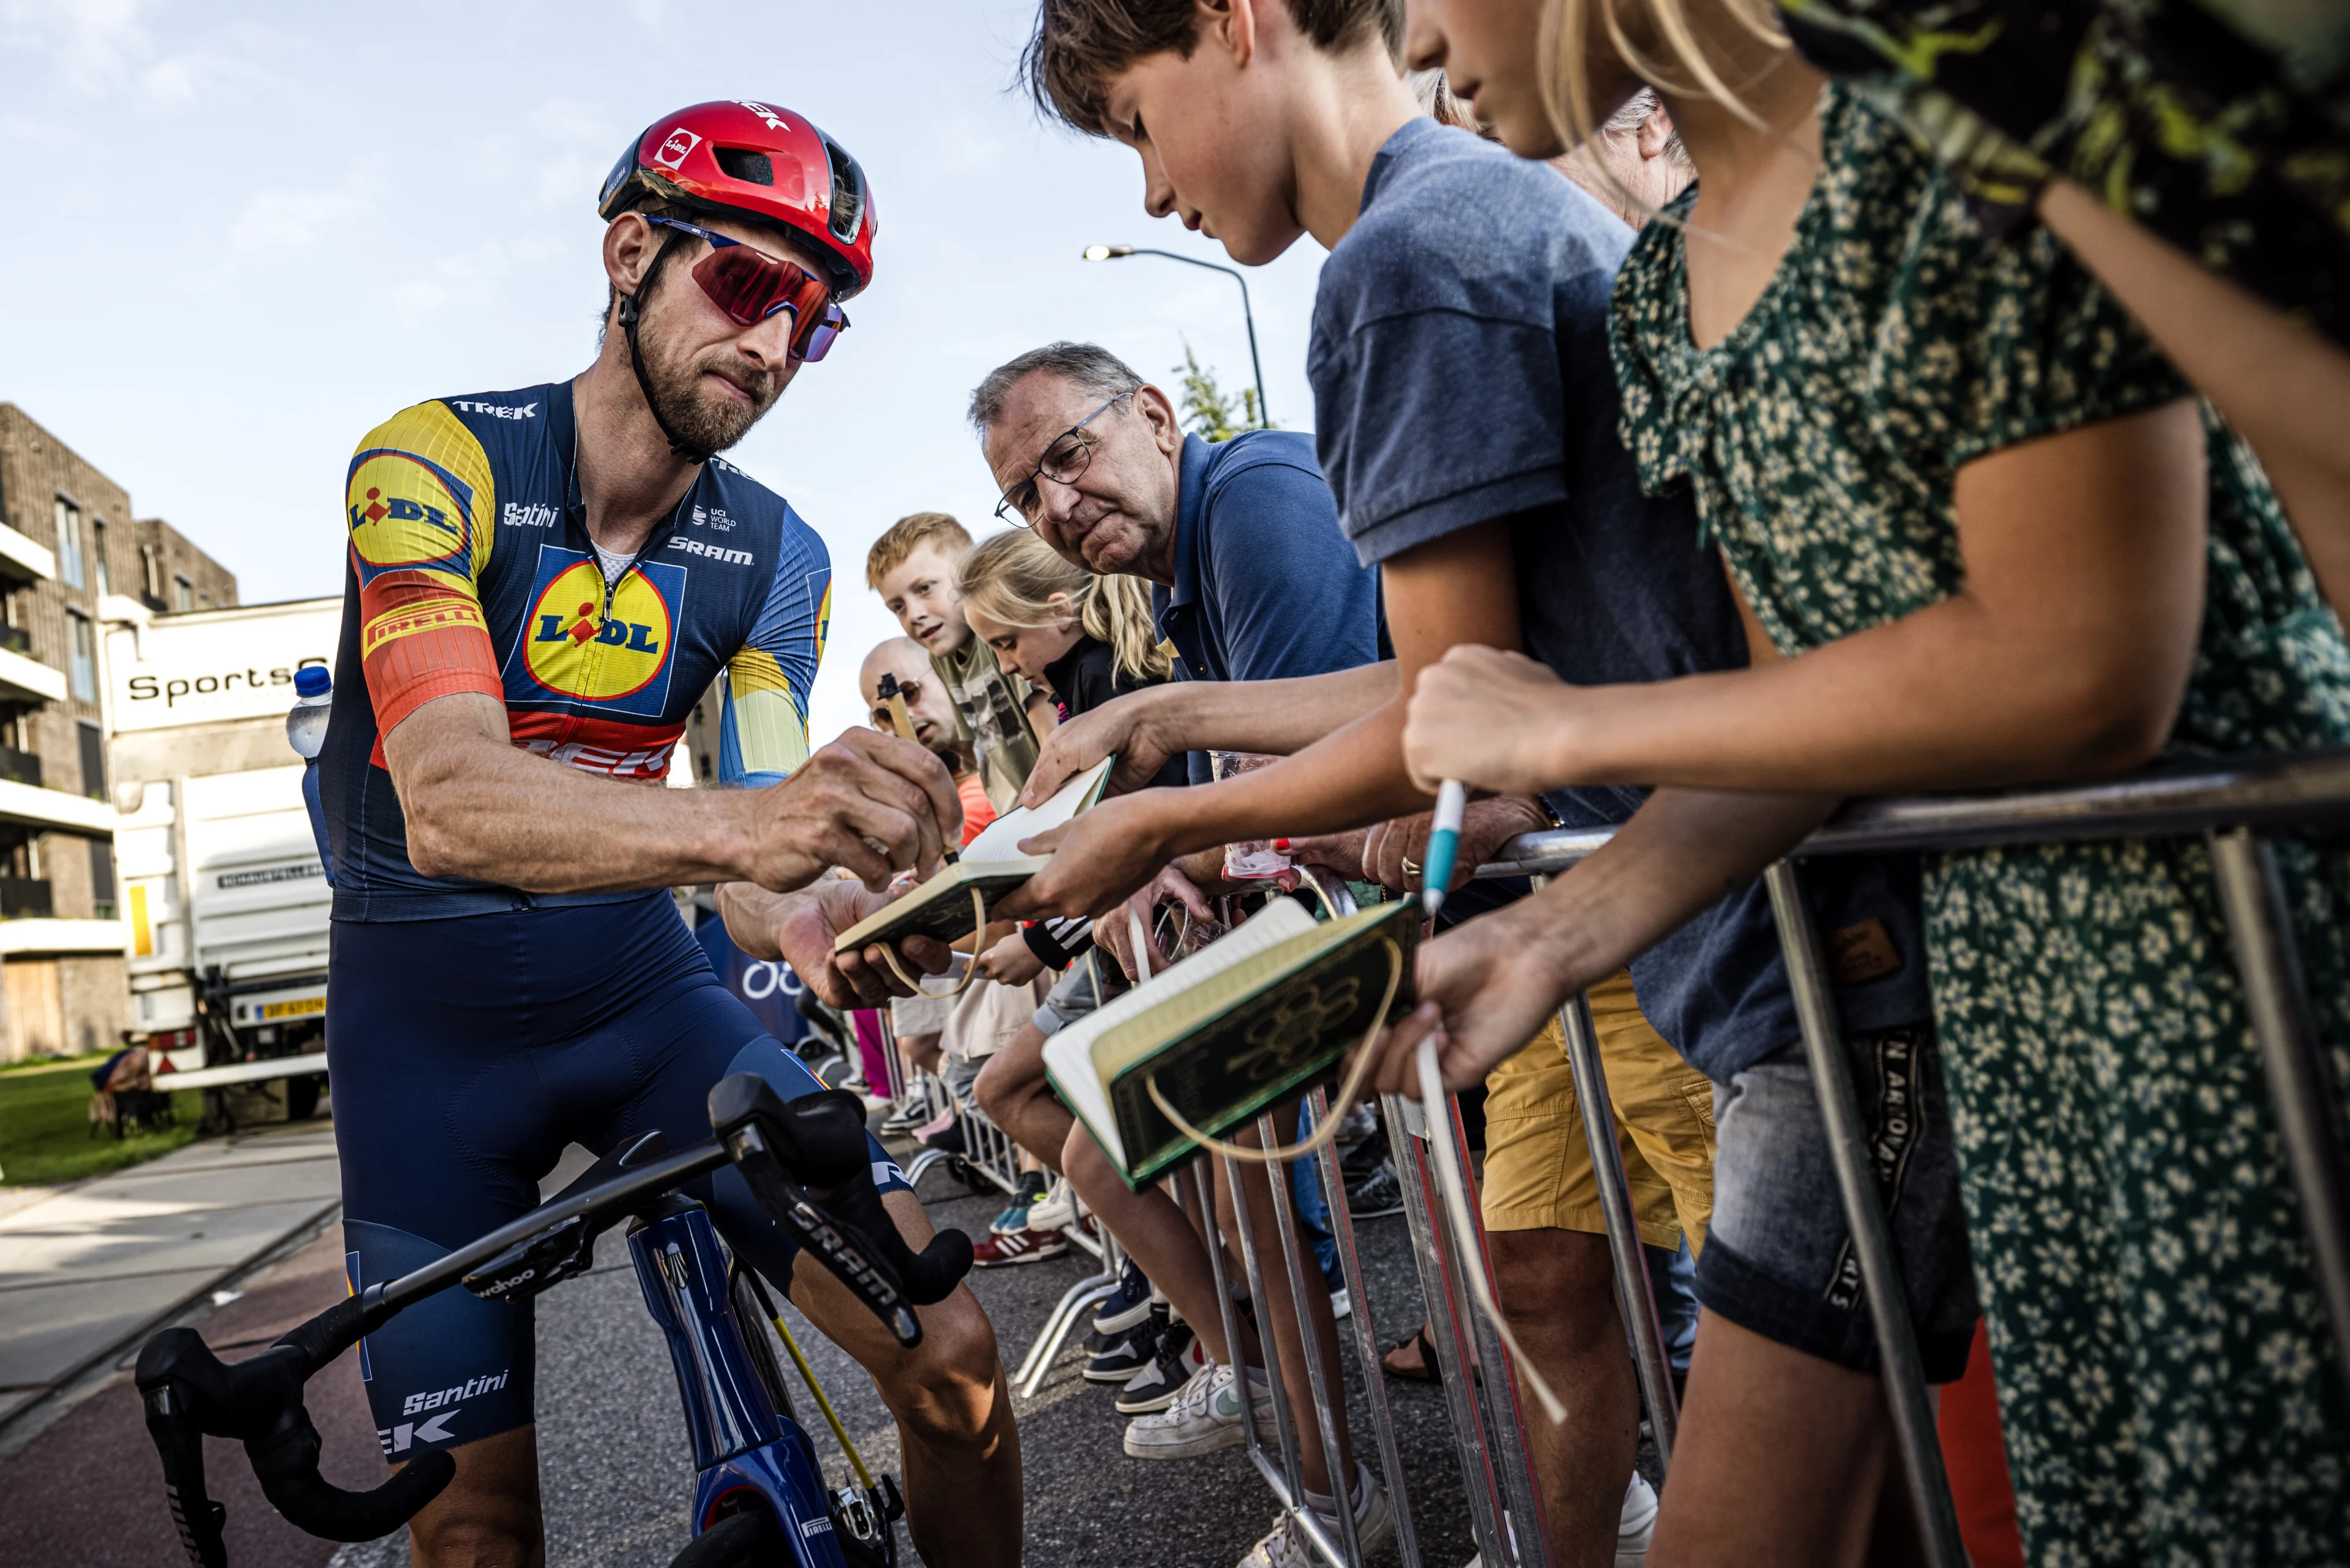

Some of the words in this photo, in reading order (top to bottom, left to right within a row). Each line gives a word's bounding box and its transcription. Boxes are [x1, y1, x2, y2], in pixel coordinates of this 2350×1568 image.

[606, 166, 625, 199] MOLLEMA
[453, 401, 539, 420] TREK
[504, 502, 559, 528] Santini
[711, 508, 726, 517] UCI
[711, 515, 736, 527] WORLD
[711, 522, 730, 532] TEAM
[667, 536, 753, 566] SRAM
[367, 603, 480, 649] PIRELLI
[788, 1201, 897, 1306] SRAM
[474, 1269, 535, 1299] wahoo
[403, 1369, 509, 1416] Santini
[801, 1516, 833, 1538] PIRELLI
